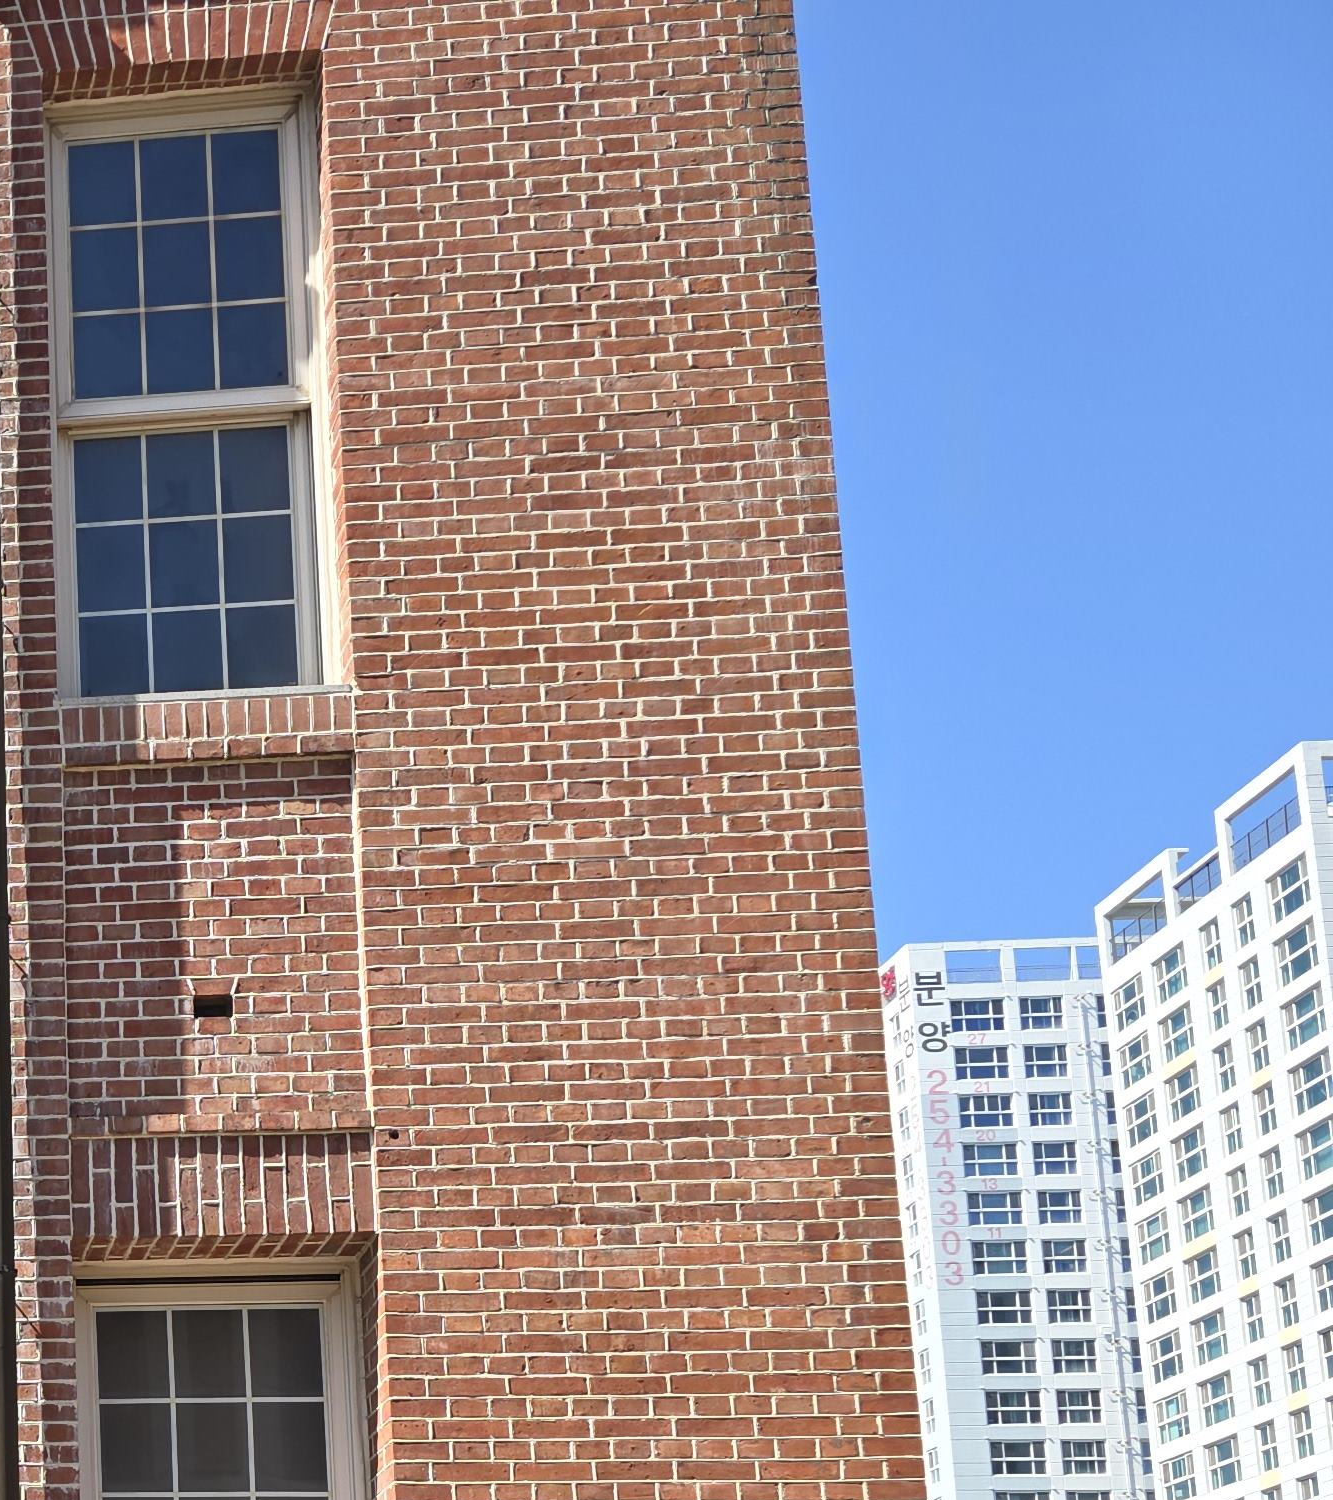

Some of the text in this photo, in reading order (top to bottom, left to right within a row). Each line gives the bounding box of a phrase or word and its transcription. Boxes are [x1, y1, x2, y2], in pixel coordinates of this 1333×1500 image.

[968, 1033, 987, 1045] 27
[974, 1081, 991, 1093] 21
[913, 971, 965, 1286] 분양 254-3303
[975, 1129, 996, 1141] 20
[981, 1178, 998, 1190] 13
[987, 1227, 1002, 1239] 11
